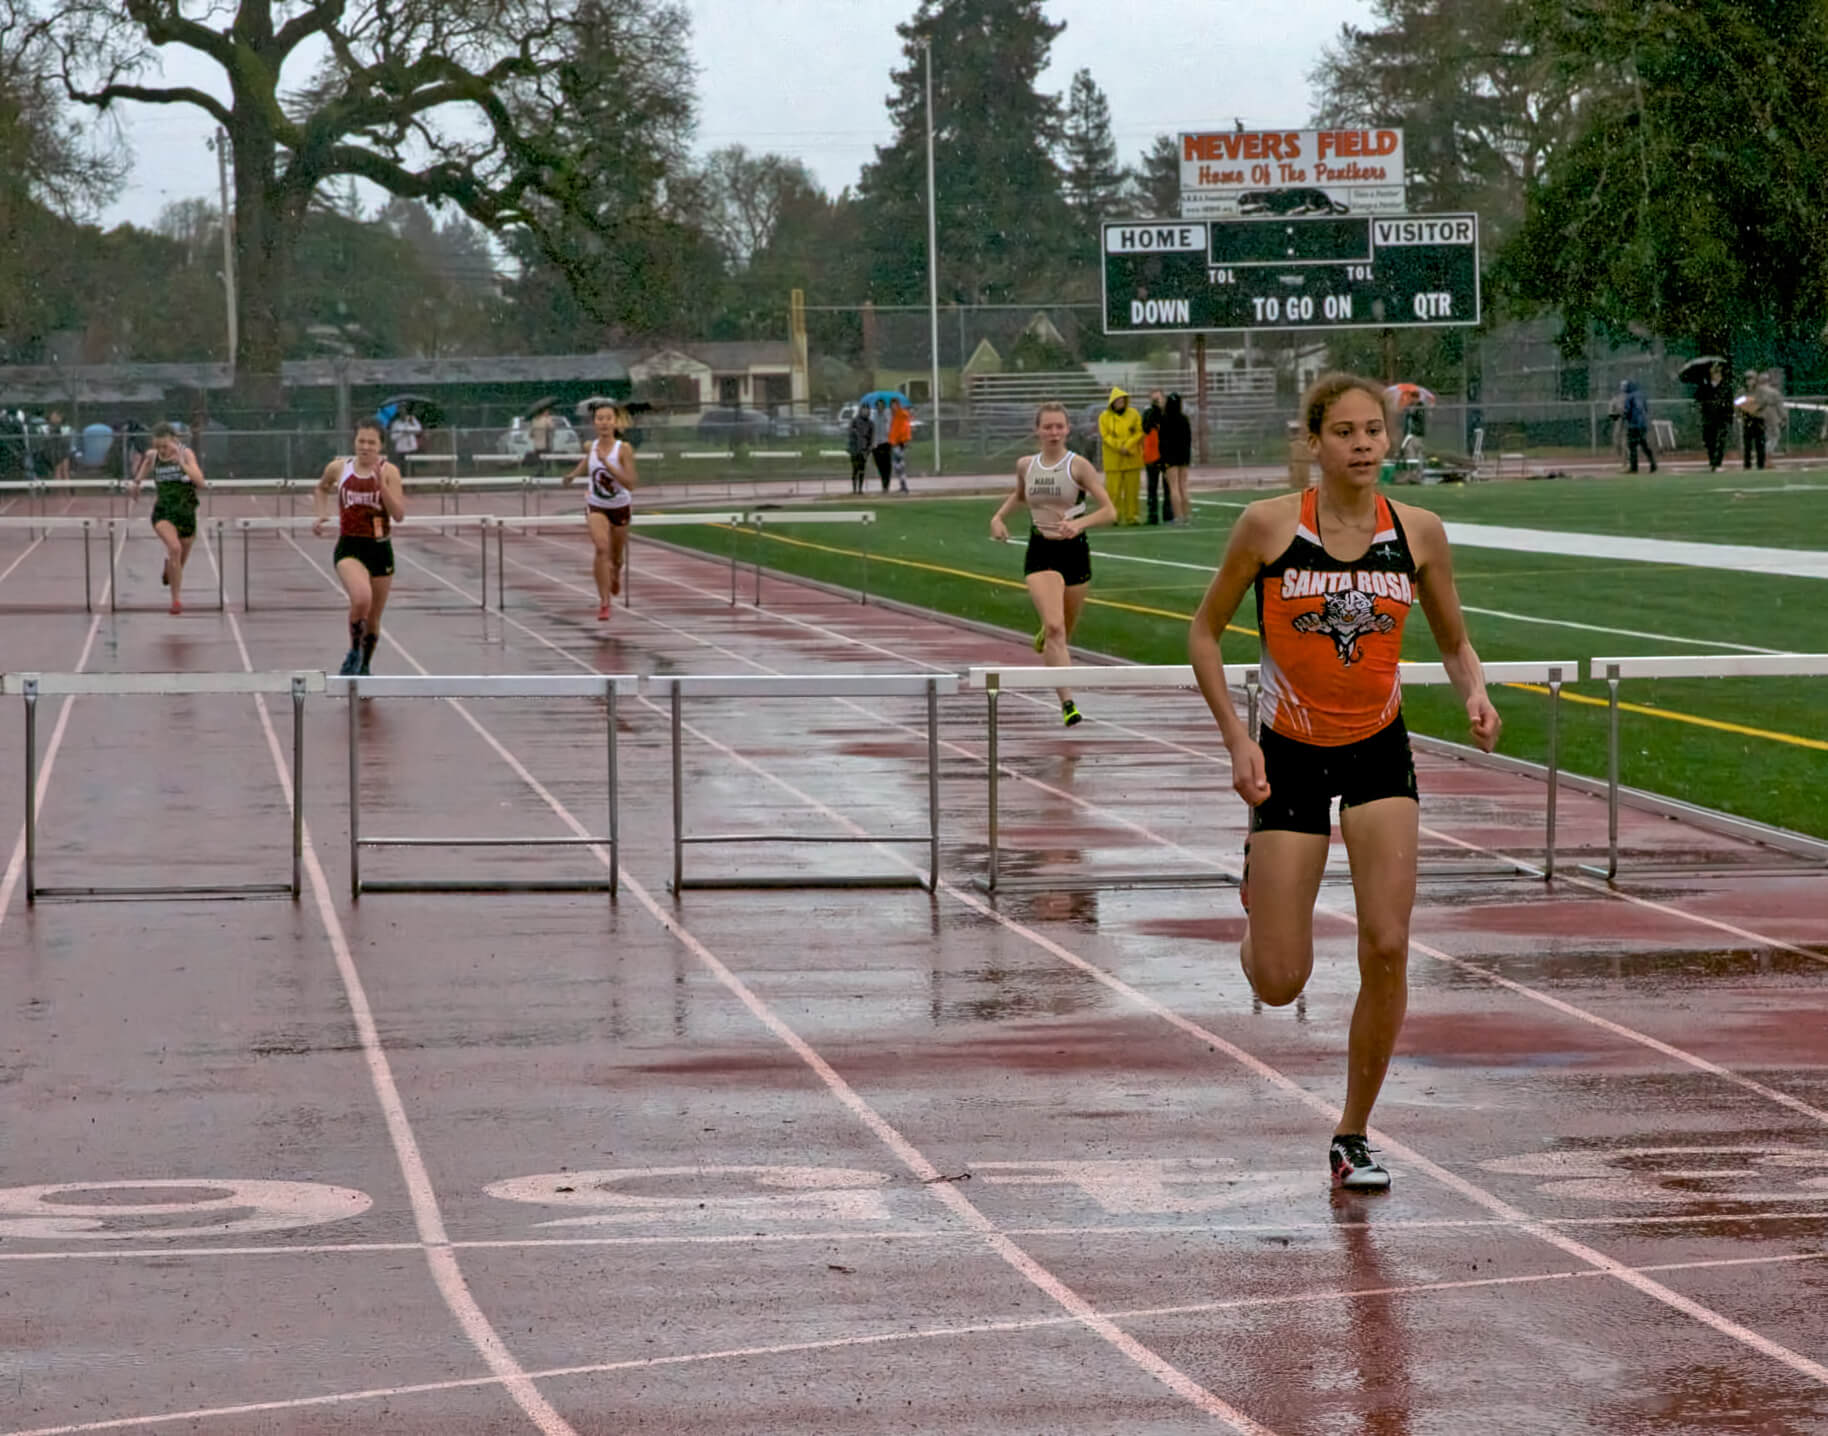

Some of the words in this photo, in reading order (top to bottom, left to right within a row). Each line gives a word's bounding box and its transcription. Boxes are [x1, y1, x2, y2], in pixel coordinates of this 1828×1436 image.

[1184, 132, 1301, 161] NEVERS
[1317, 130, 1398, 160] FIELD
[1198, 165, 1245, 185] Home
[1251, 164, 1271, 185] Of
[1278, 162, 1306, 184] The
[1314, 161, 1387, 182] Panthers
[1120, 228, 1193, 249] HOME
[1378, 223, 1471, 242] VISITOR
[1208, 269, 1236, 284] TOL
[1346, 266, 1374, 280] TOL
[1130, 300, 1190, 324] DOWN
[1252, 297, 1280, 321] TO
[1285, 296, 1313, 320] GO
[1324, 295, 1352, 319] ON
[1413, 292, 1452, 320] QTR
[1280, 567, 1354, 600] SANTA
[1356, 571, 1413, 607] ROSA
